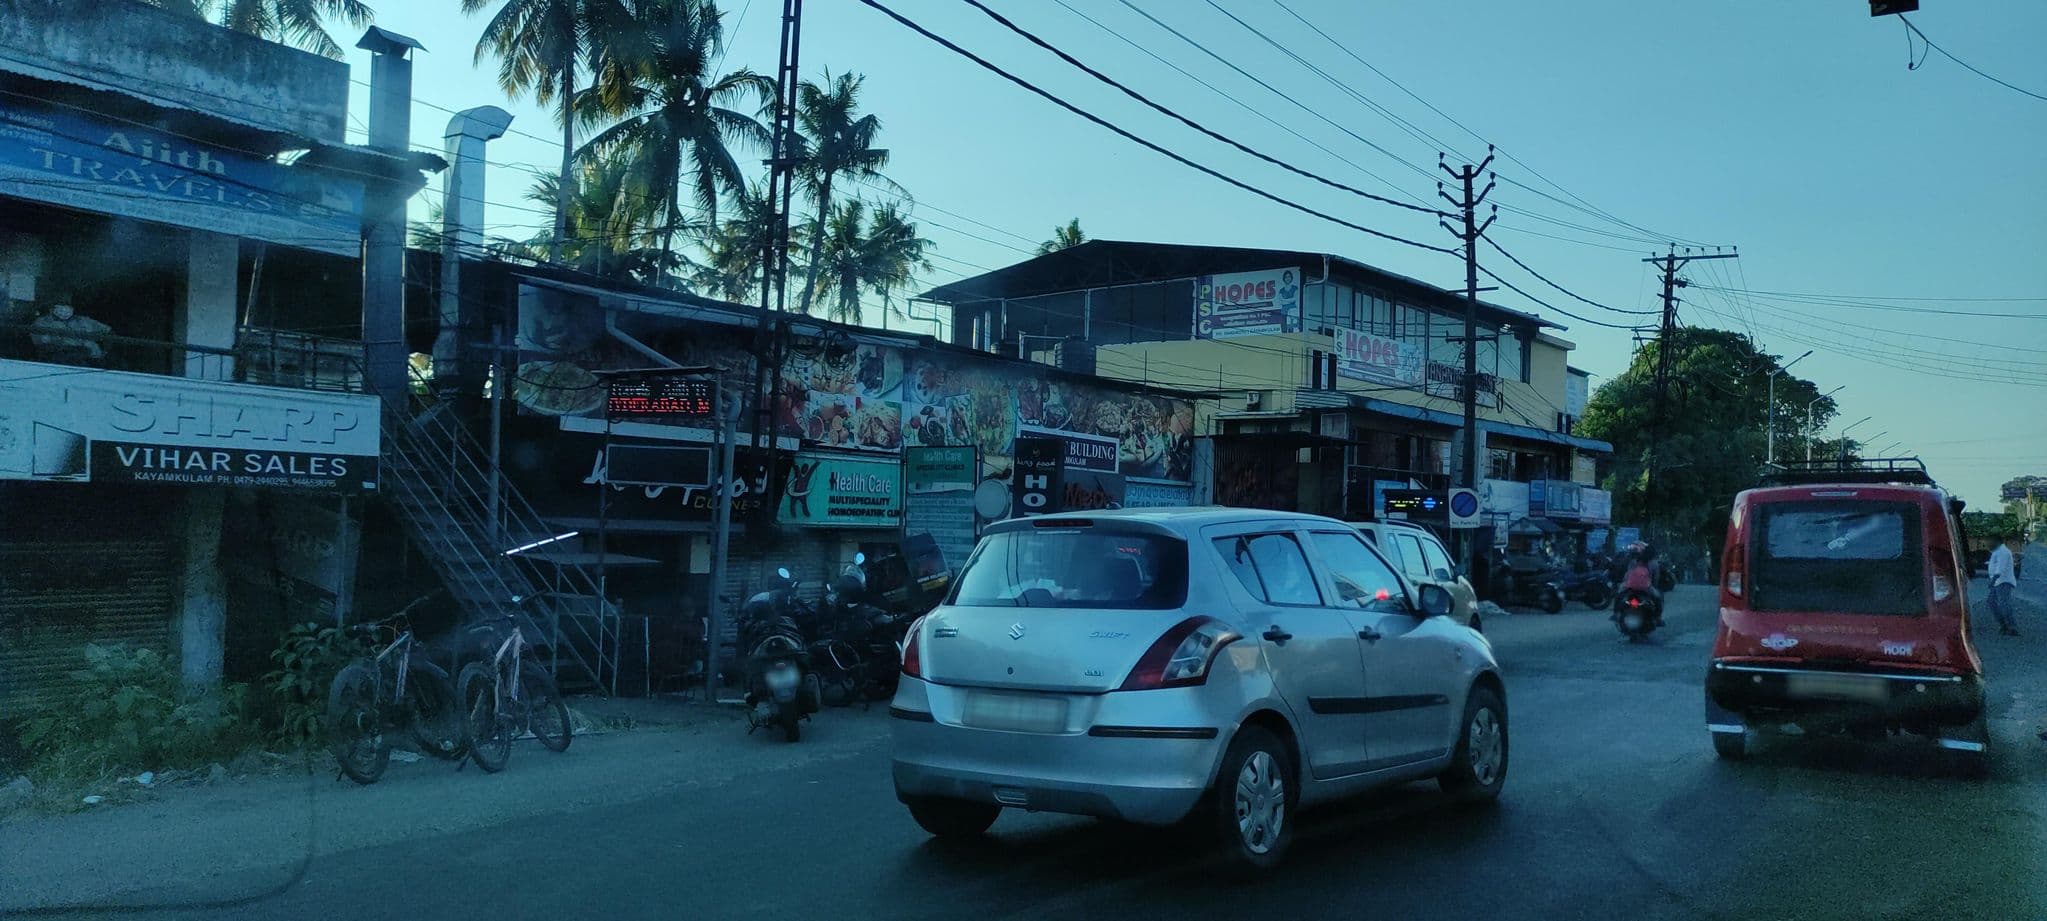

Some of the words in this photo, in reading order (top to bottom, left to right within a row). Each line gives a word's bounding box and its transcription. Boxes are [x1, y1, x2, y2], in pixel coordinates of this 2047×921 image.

[103, 131, 225, 176] Ajith
[32, 148, 272, 211] TRAVELS
[1215, 280, 1275, 304] HOPES
[1199, 284, 1211, 334] PSC
[1346, 330, 1399, 365] HOPES
[111, 393, 359, 445] SHARP
[115, 446, 231, 472] VIHAR
[244, 454, 348, 477] SALES
[1070, 441, 1114, 460] BUILDING
[134, 471, 212, 483] KAYAMKULAM
[830, 472, 865, 493] Health
[868, 474, 891, 493] Care
[1089, 631, 1130, 639] SWIFT
